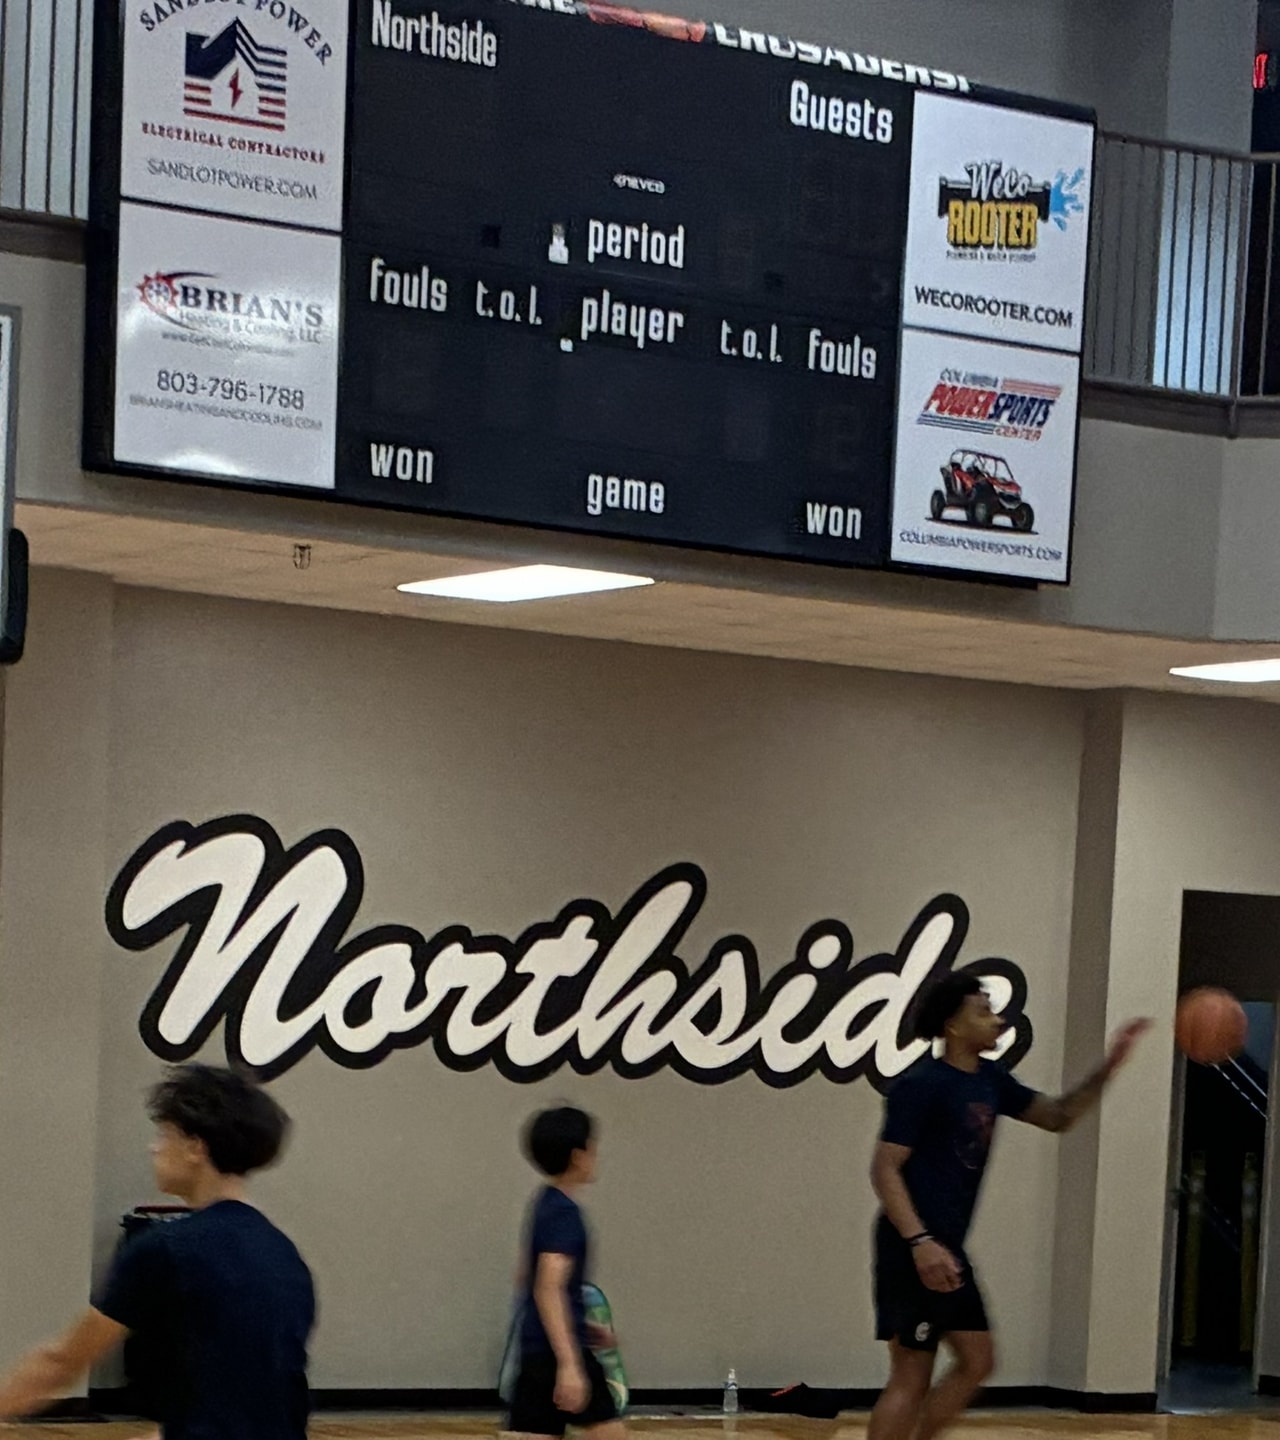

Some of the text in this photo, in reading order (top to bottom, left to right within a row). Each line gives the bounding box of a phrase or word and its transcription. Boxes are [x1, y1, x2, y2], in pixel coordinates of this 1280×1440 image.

[255, 0, 332, 66] POWER
[371, 0, 498, 68] Northside
[142, 121, 223, 147] ELECTRICAL
[790, 79, 893, 144] Guests
[587, 218, 685, 269] period
[947, 200, 1038, 249] ROOTER
[180, 284, 324, 328] BRIAN'S
[475, 280, 543, 325] t.o.l.
[581, 288, 684, 349] player
[721, 319, 783, 363] t.o.l.
[914, 285, 1073, 328] WECOROOTER.COM
[156, 369, 305, 411] 803-796-1788
[370, 443, 862, 540] won game won
